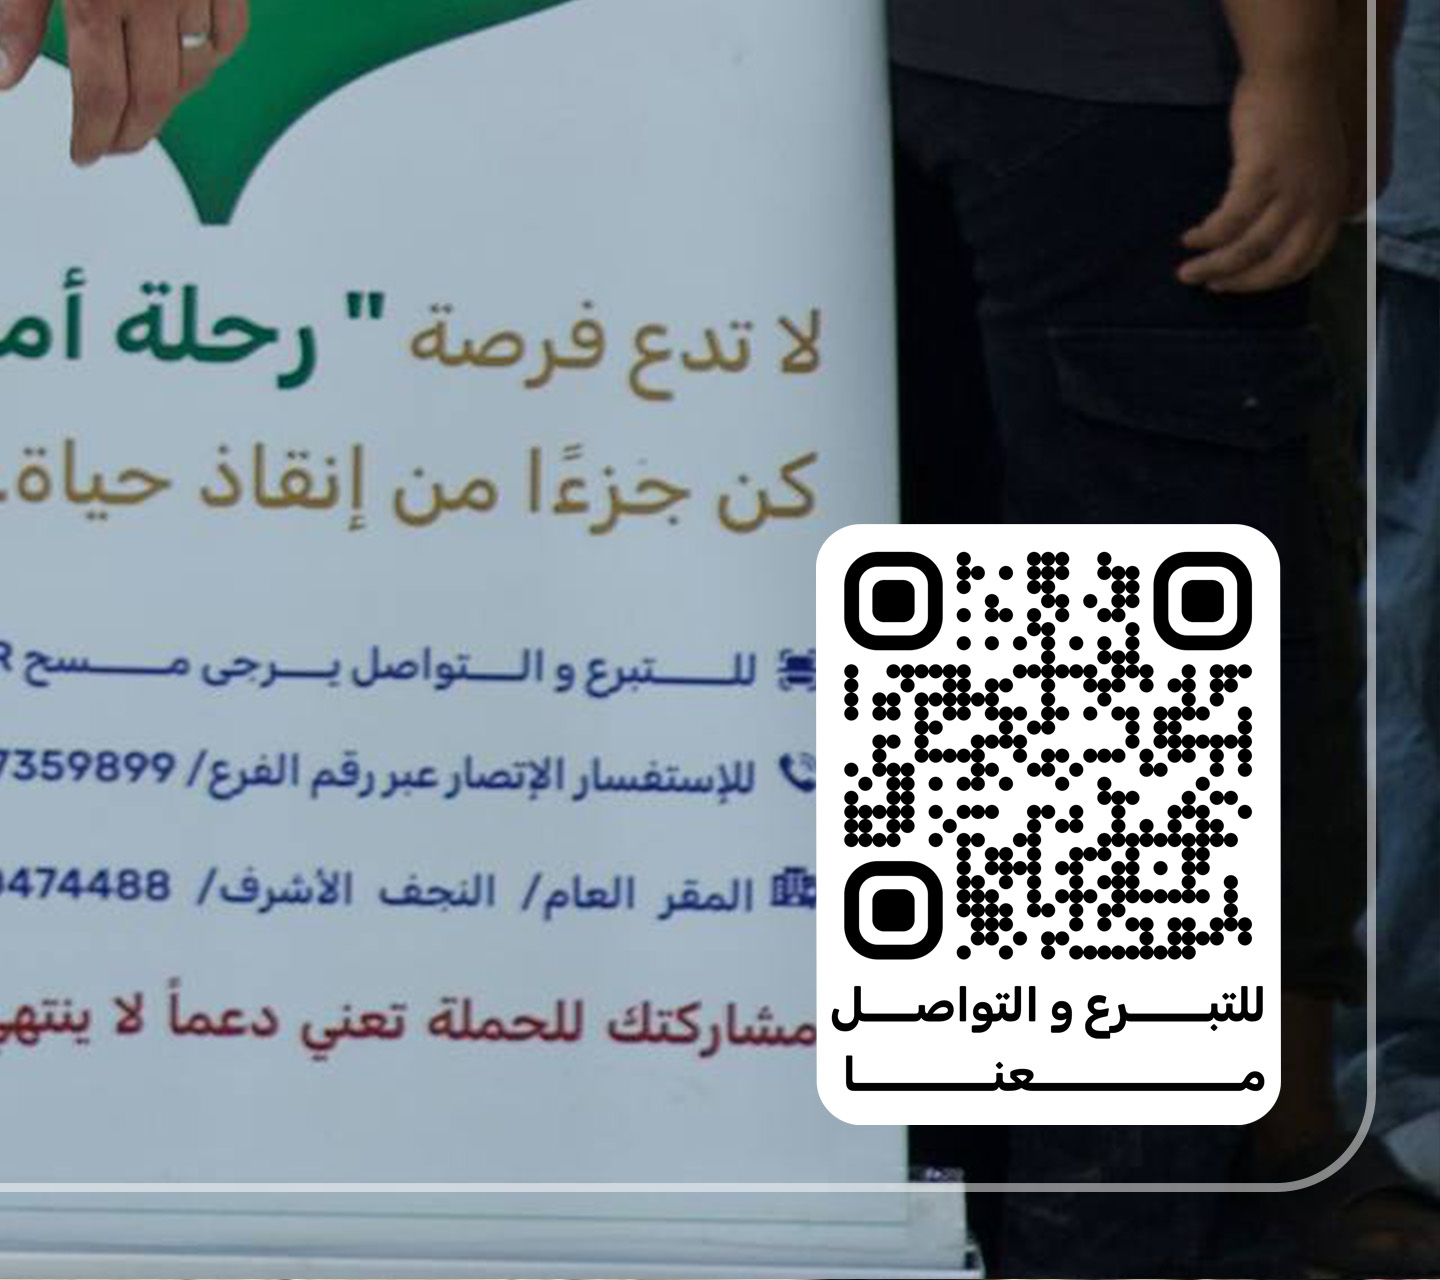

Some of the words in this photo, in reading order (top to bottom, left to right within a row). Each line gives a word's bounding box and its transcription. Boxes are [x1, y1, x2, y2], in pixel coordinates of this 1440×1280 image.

[115, 282, 316, 390] رحلة
[410, 301, 605, 389] فرصة
[628, 321, 754, 402] تدع
[778, 308, 821, 374] لا
[200, 442, 365, 531] إنقاذ
[393, 468, 498, 527] من
[718, 452, 818, 534] كن
[554, 664, 575, 693] و
[311, 751, 374, 799] رقم
[381, 767, 438, 798] عبر
[379, 874, 494, 907] النجف
[657, 879, 752, 920] المقر
[114, 992, 143, 1035] لا
[301, 1004, 406, 1061] تعني
[428, 997, 583, 1042] للحملة
[607, 999, 816, 1059] مشاركتك
